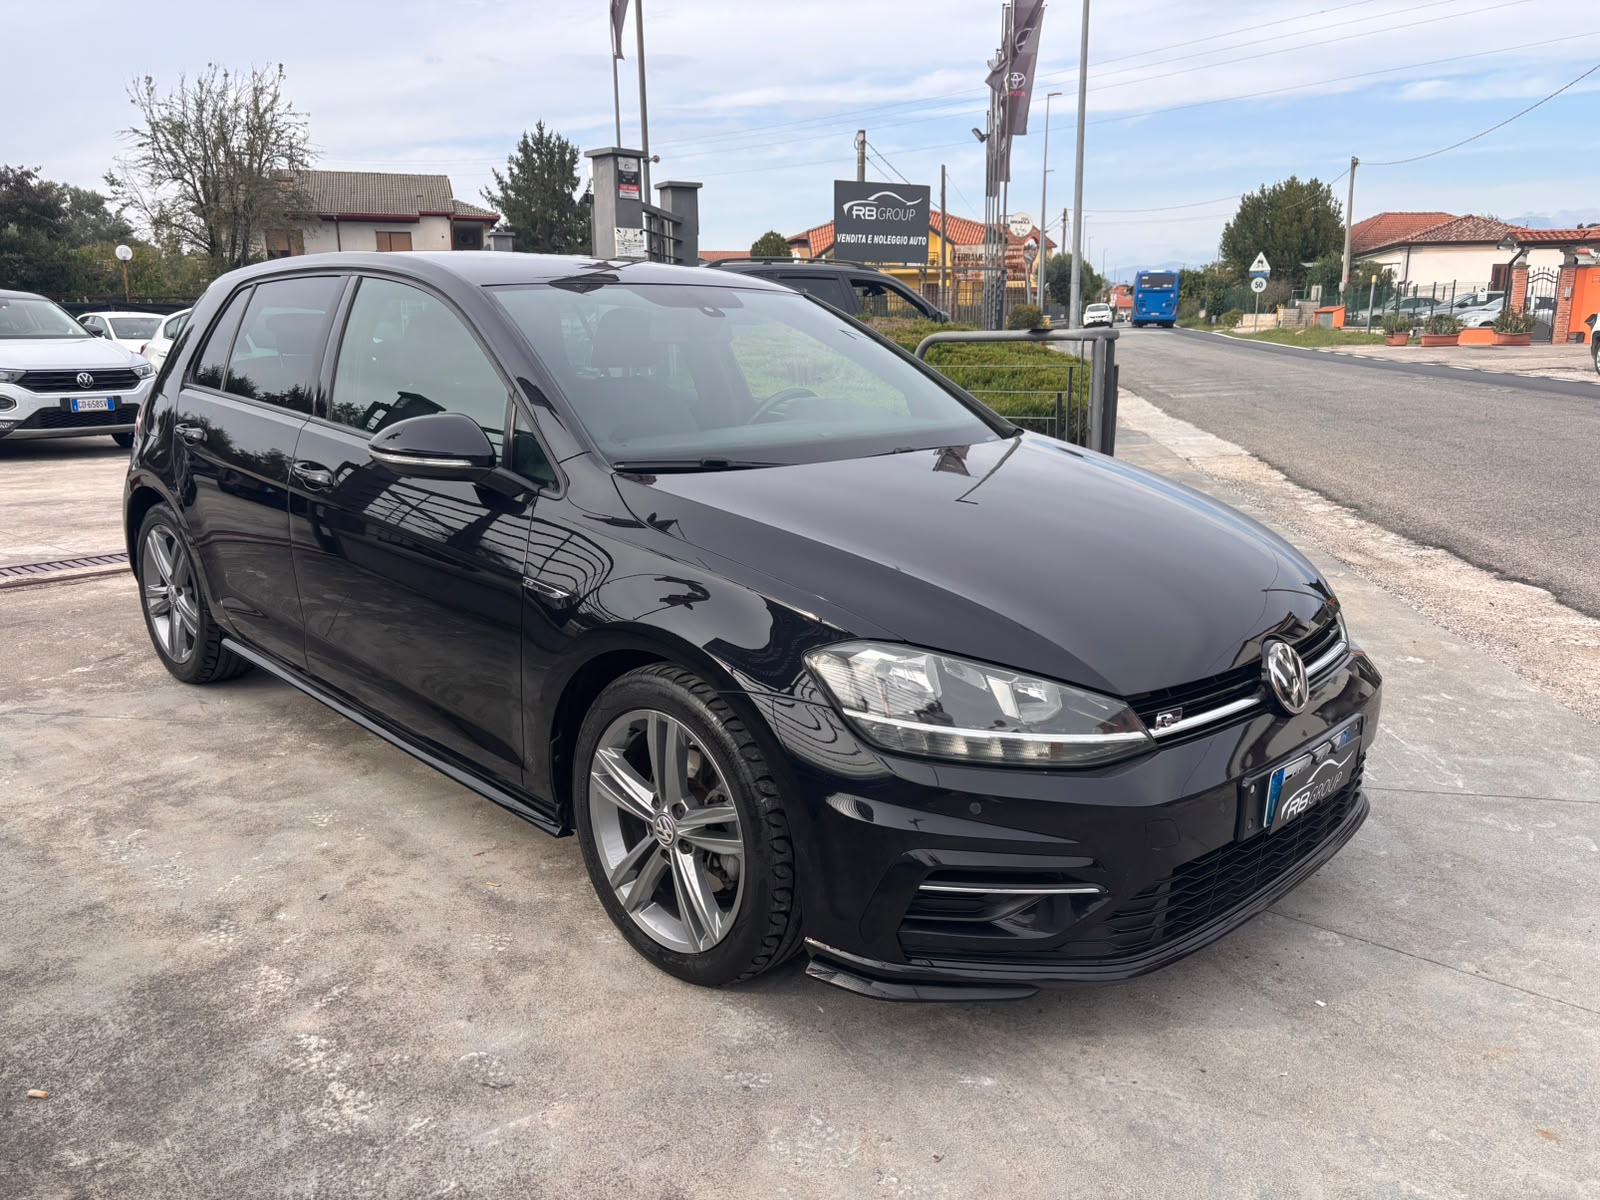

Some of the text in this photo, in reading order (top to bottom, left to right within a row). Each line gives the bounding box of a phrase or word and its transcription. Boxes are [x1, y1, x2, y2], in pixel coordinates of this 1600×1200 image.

[837, 233, 927, 246] VENDITA E NOLEGGIO AUTO
[1255, 281, 1263, 289] 50
